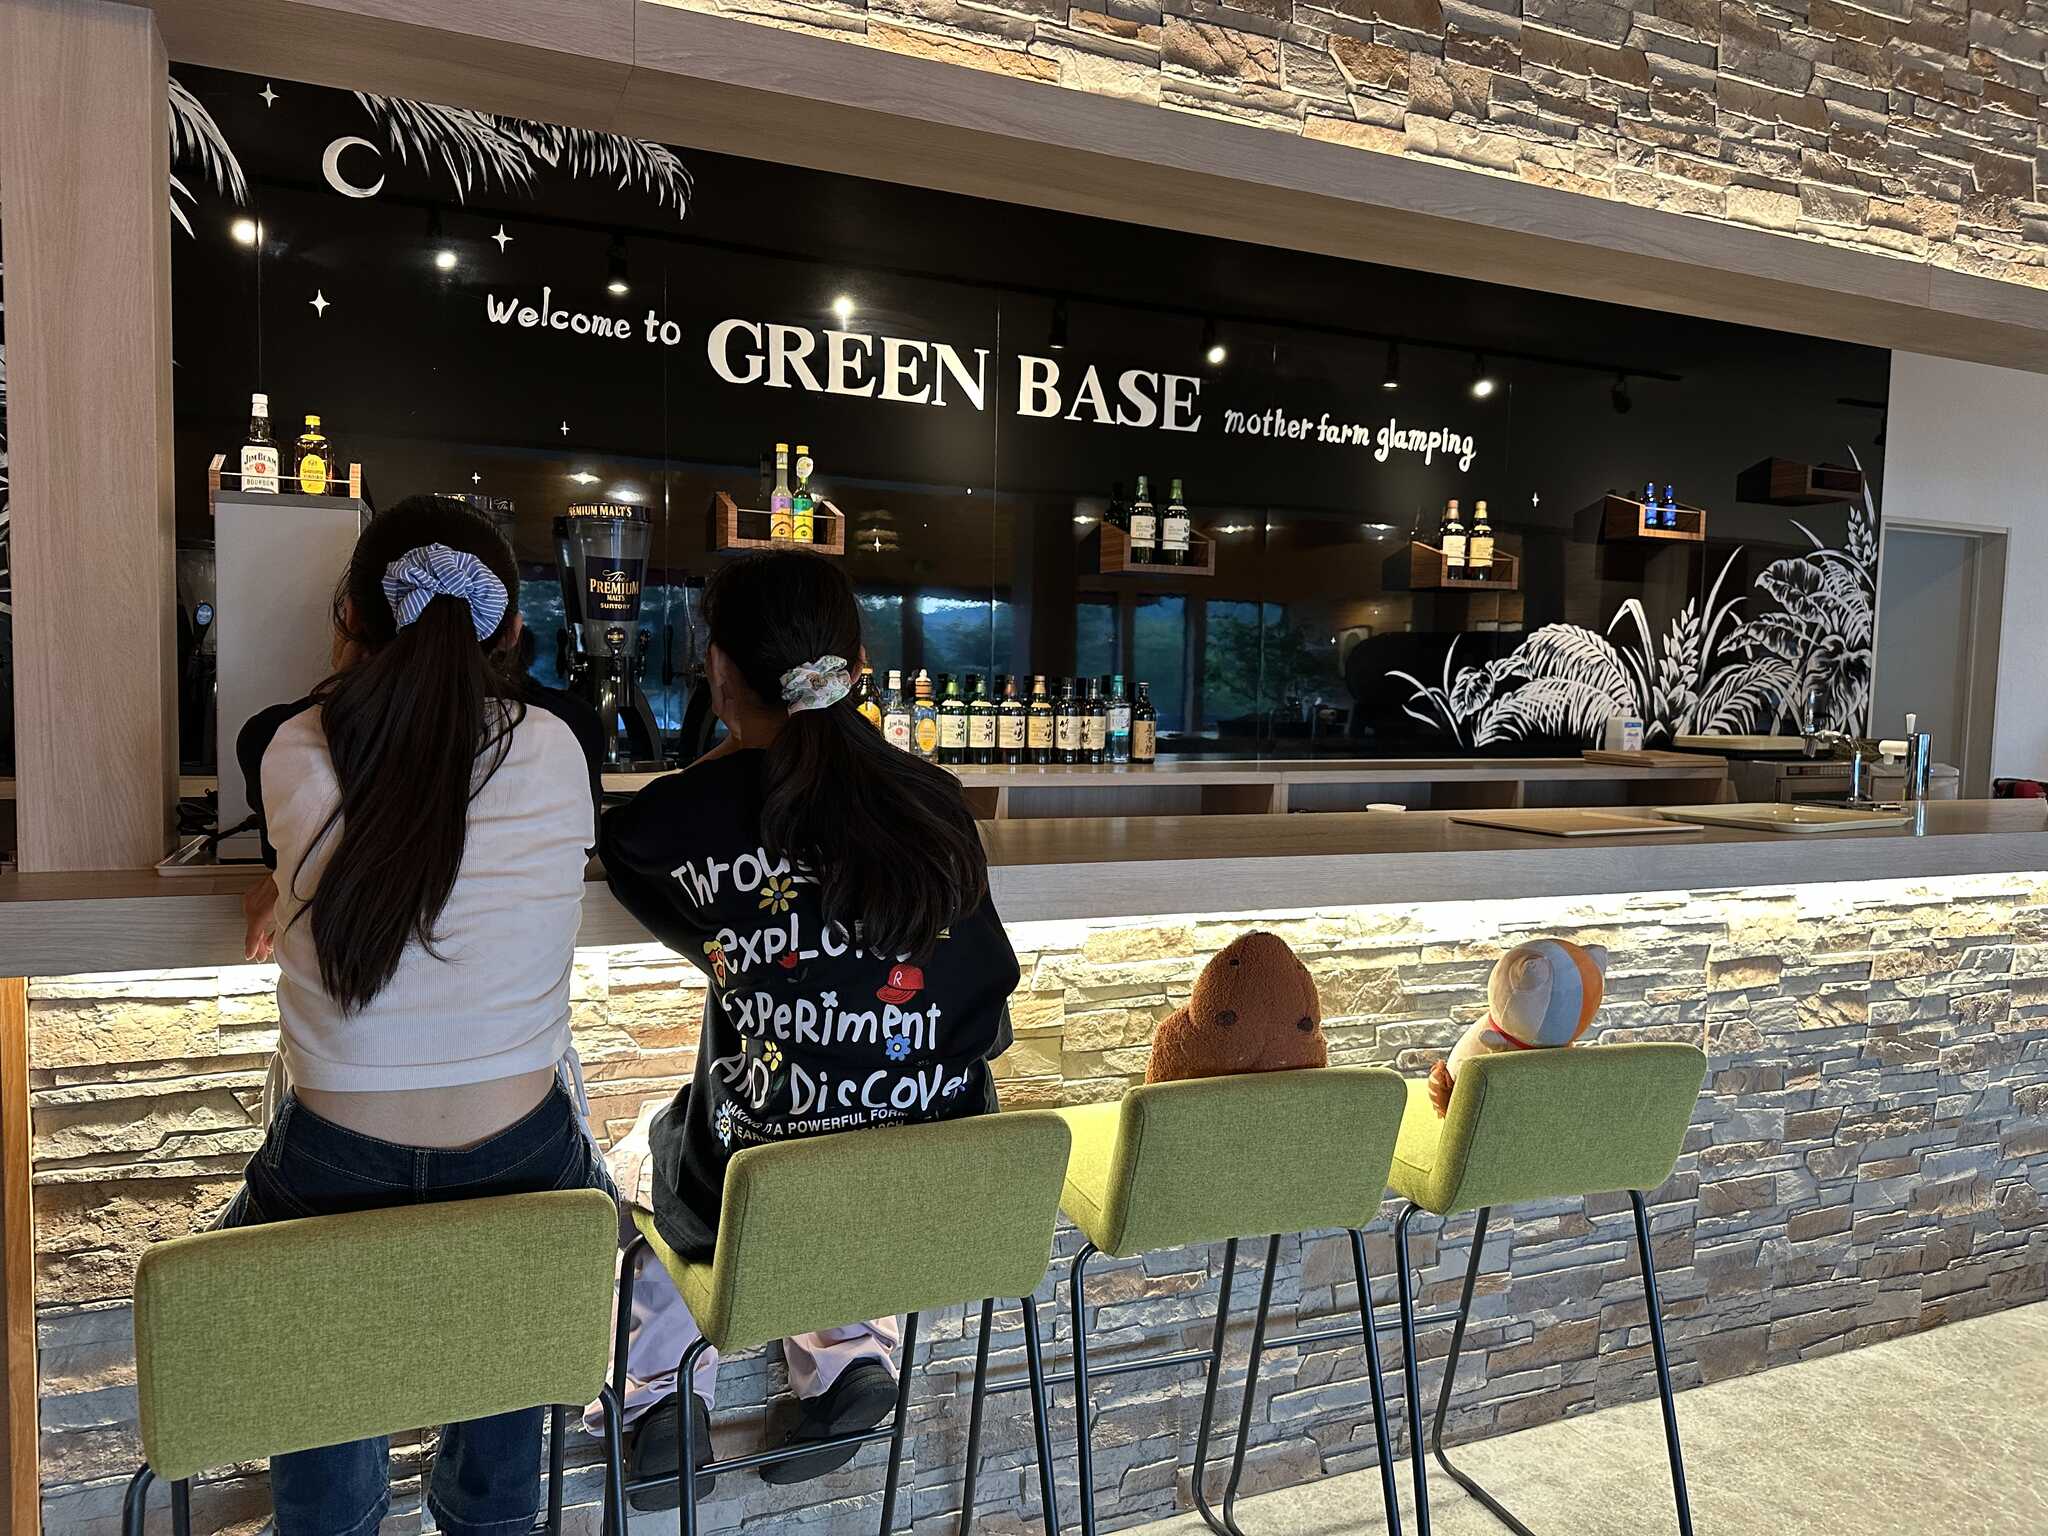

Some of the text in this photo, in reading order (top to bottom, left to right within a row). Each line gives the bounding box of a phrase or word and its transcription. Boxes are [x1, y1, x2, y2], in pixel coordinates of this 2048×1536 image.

[487, 286, 682, 346] Welcome to
[707, 318, 1202, 433] GREEN BASE
[1224, 406, 1477, 473] mother farm glamping
[589, 578, 640, 595] PREMIUM
[671, 847, 820, 908] Throu
[787, 1111, 867, 1135] POWERFUL
